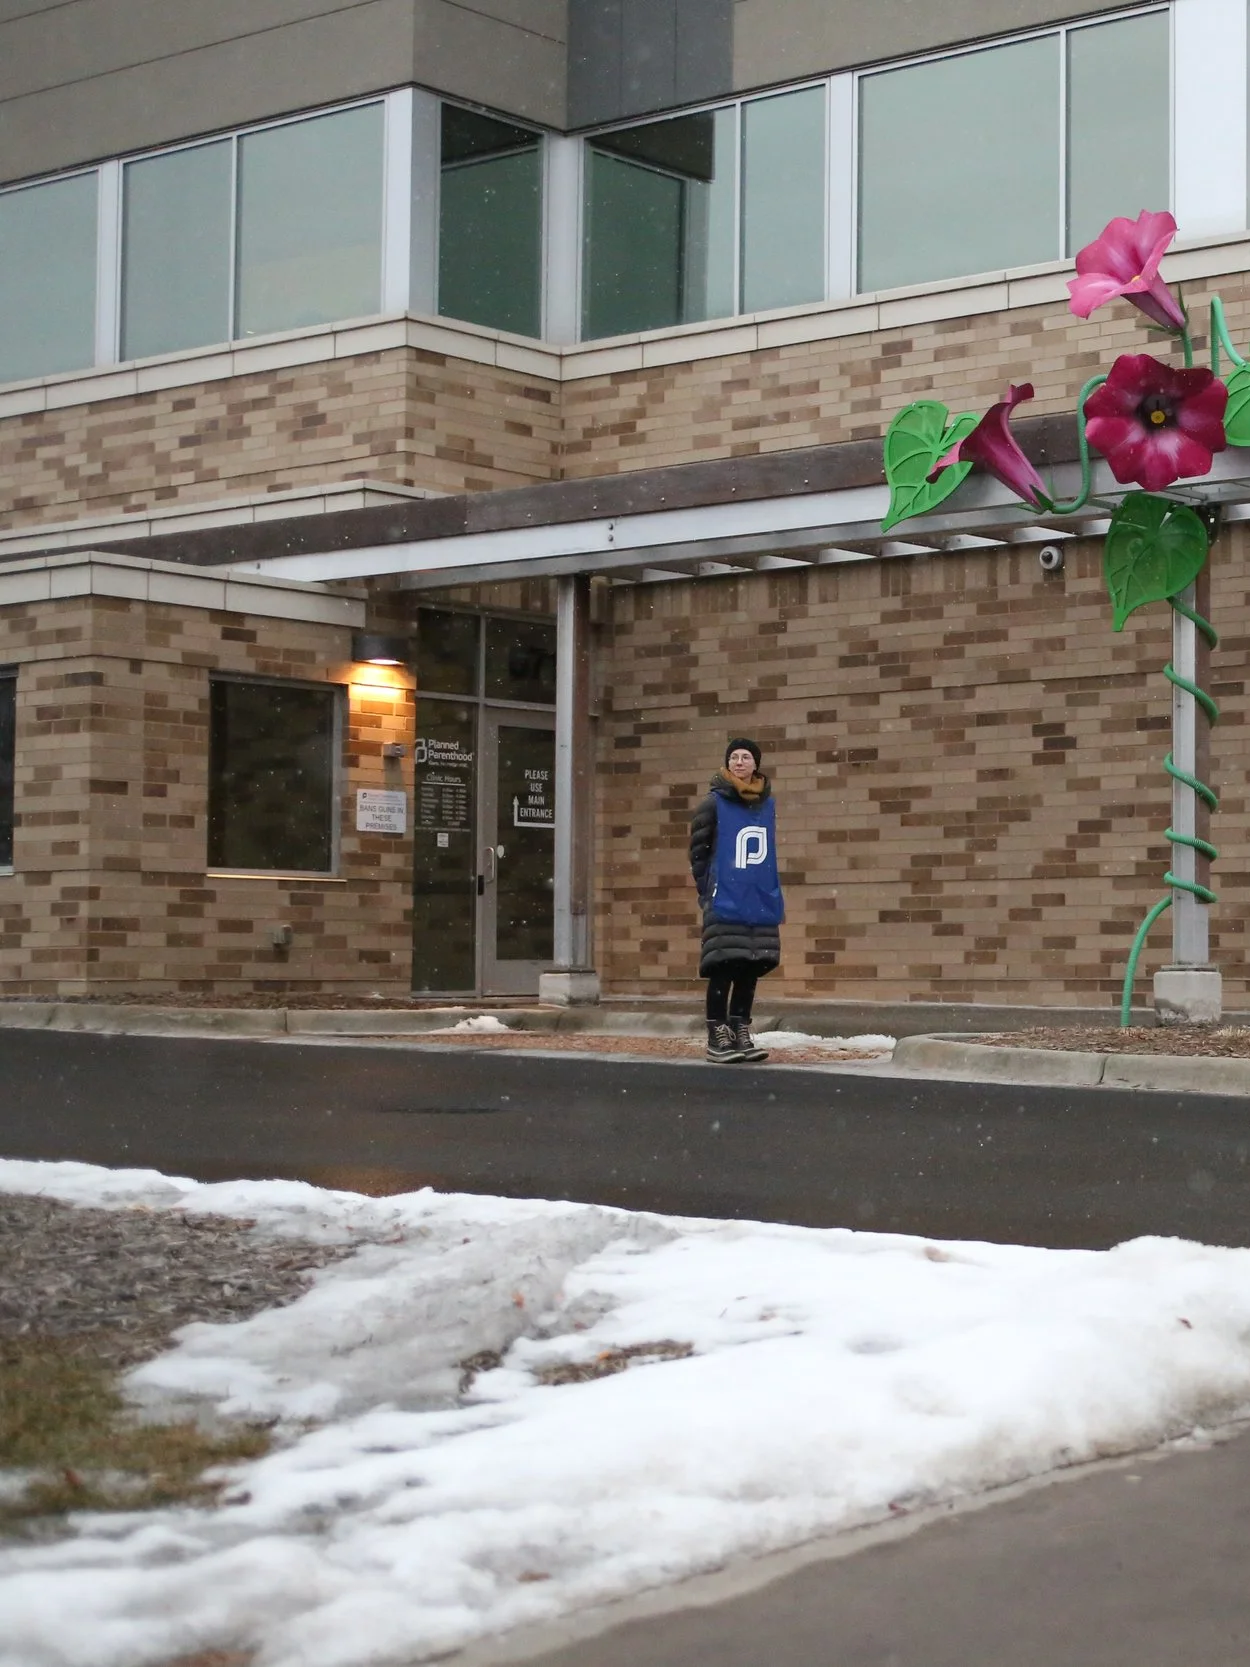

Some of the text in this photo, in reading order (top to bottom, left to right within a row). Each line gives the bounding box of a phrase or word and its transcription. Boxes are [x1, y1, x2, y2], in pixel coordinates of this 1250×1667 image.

[428, 739, 459, 750] Planned
[428, 750, 473, 761] Parenthood
[524, 769, 549, 780] PLEASE
[530, 782, 543, 792] USE
[528, 795, 545, 805] MAIN
[371, 813, 392, 822] THESE
[520, 807, 553, 818] ENTRANCE
